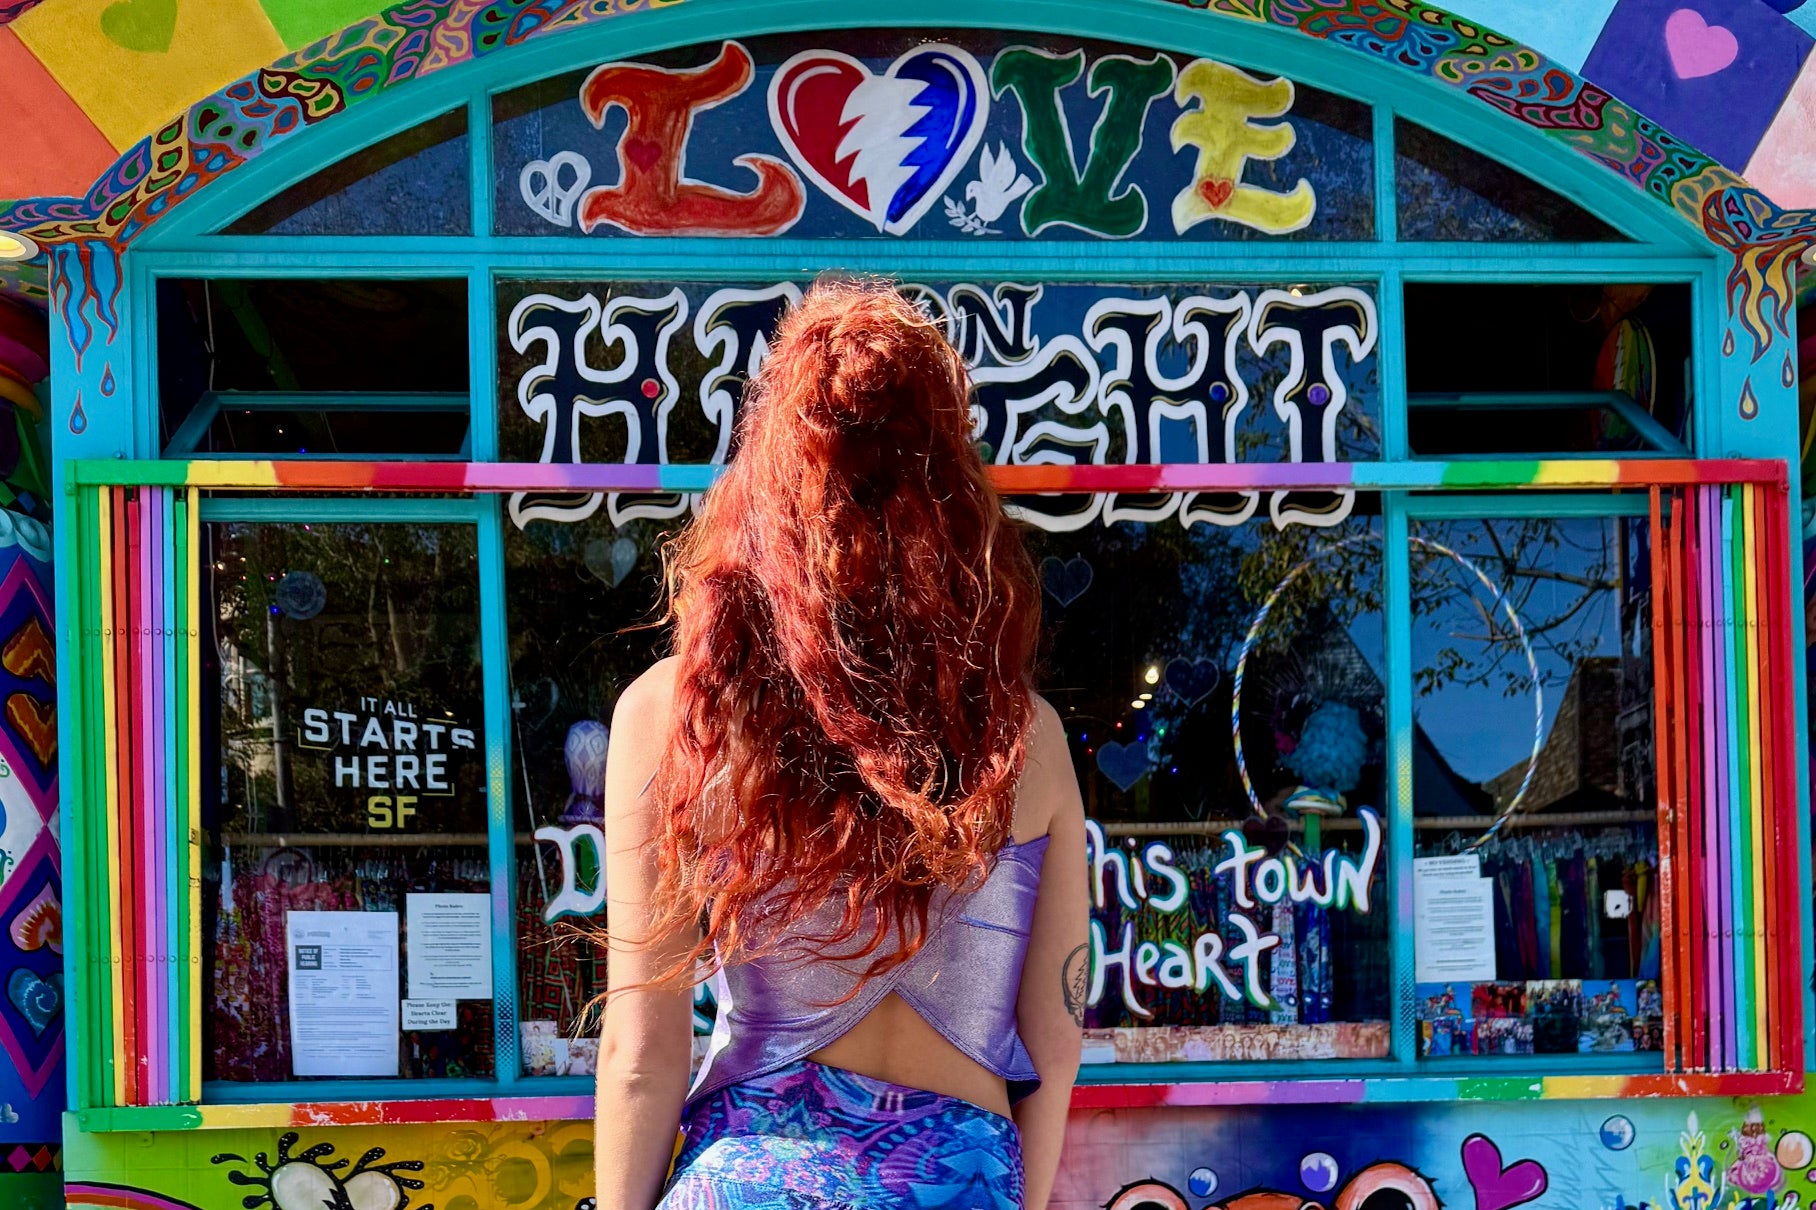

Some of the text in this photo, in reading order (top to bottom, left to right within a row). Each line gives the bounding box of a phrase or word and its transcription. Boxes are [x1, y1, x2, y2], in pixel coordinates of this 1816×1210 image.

[361, 697, 417, 718] IT ALL
[304, 708, 475, 750] STARTS
[335, 754, 448, 789] HERE
[368, 795, 418, 828] SF
